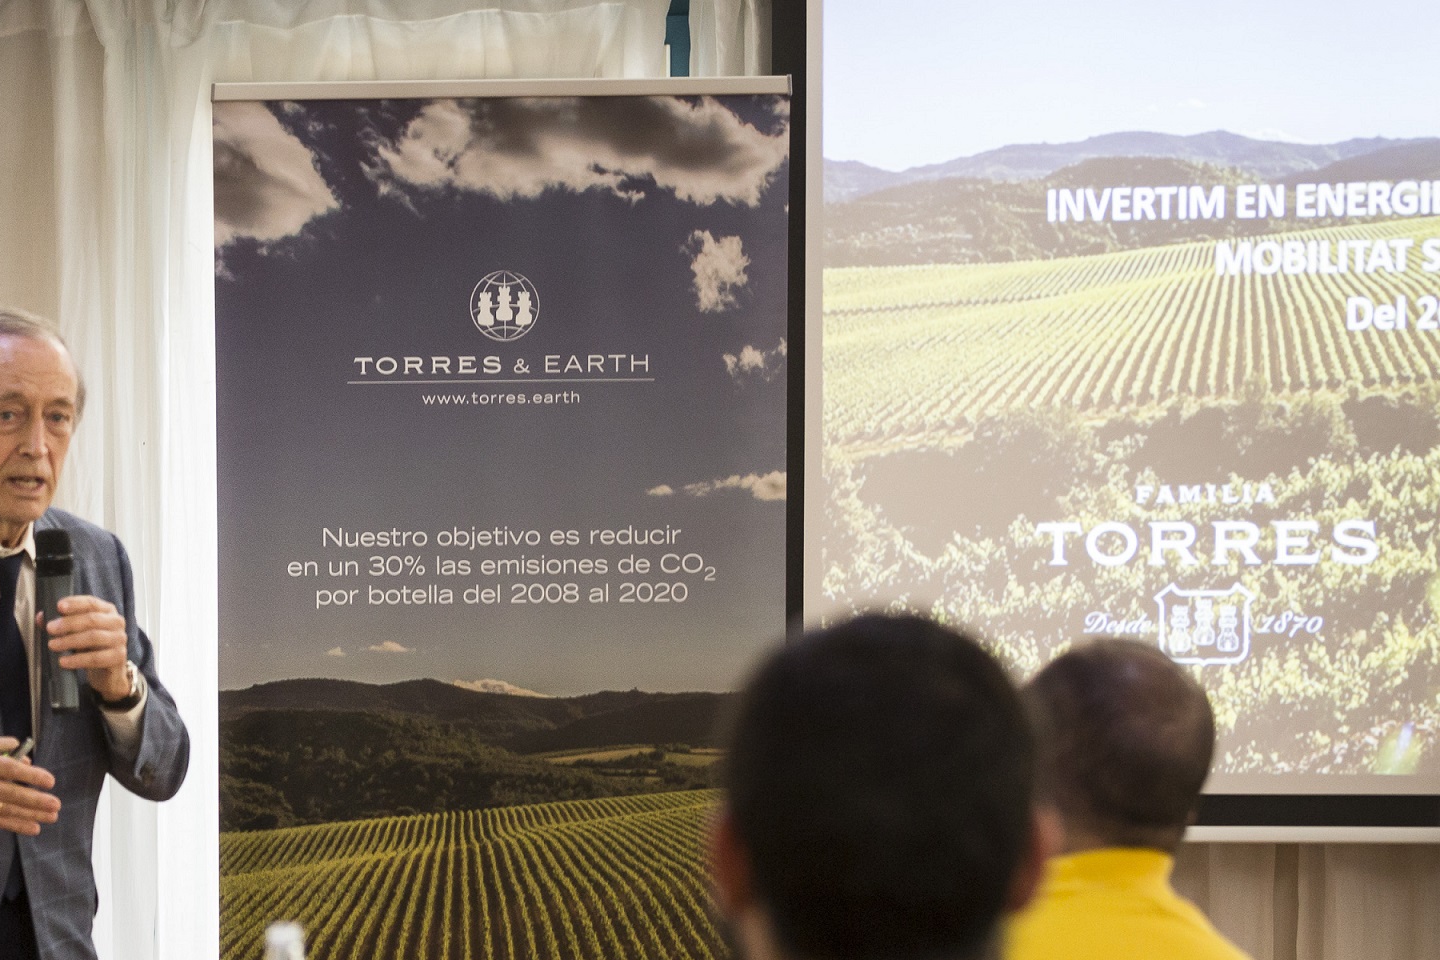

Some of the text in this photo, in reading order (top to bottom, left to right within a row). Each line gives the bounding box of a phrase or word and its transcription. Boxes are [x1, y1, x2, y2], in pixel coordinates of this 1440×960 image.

[1047, 186, 1225, 222] INVERTIM
[1235, 183, 1286, 219] EN
[1215, 239, 1413, 275] MOBILITAT
[1346, 294, 1440, 331] Del 2
[353, 354, 649, 375] TORRES & EARTH
[421, 390, 581, 405] www.torres.earth
[1135, 484, 1275, 504] FAMILIA
[322, 525, 682, 550] Nuestro objetivo es reducir
[1035, 520, 1379, 566] TORRES
[287, 560, 319, 577] en
[328, 560, 359, 577] un
[368, 555, 426, 576] 30%
[436, 555, 472, 576] las
[480, 554, 609, 576] emisiones
[617, 554, 651, 574] de
[316, 582, 688, 609] por botella del 2008 al 2020
[1083, 611, 1324, 637] Desde 1870
